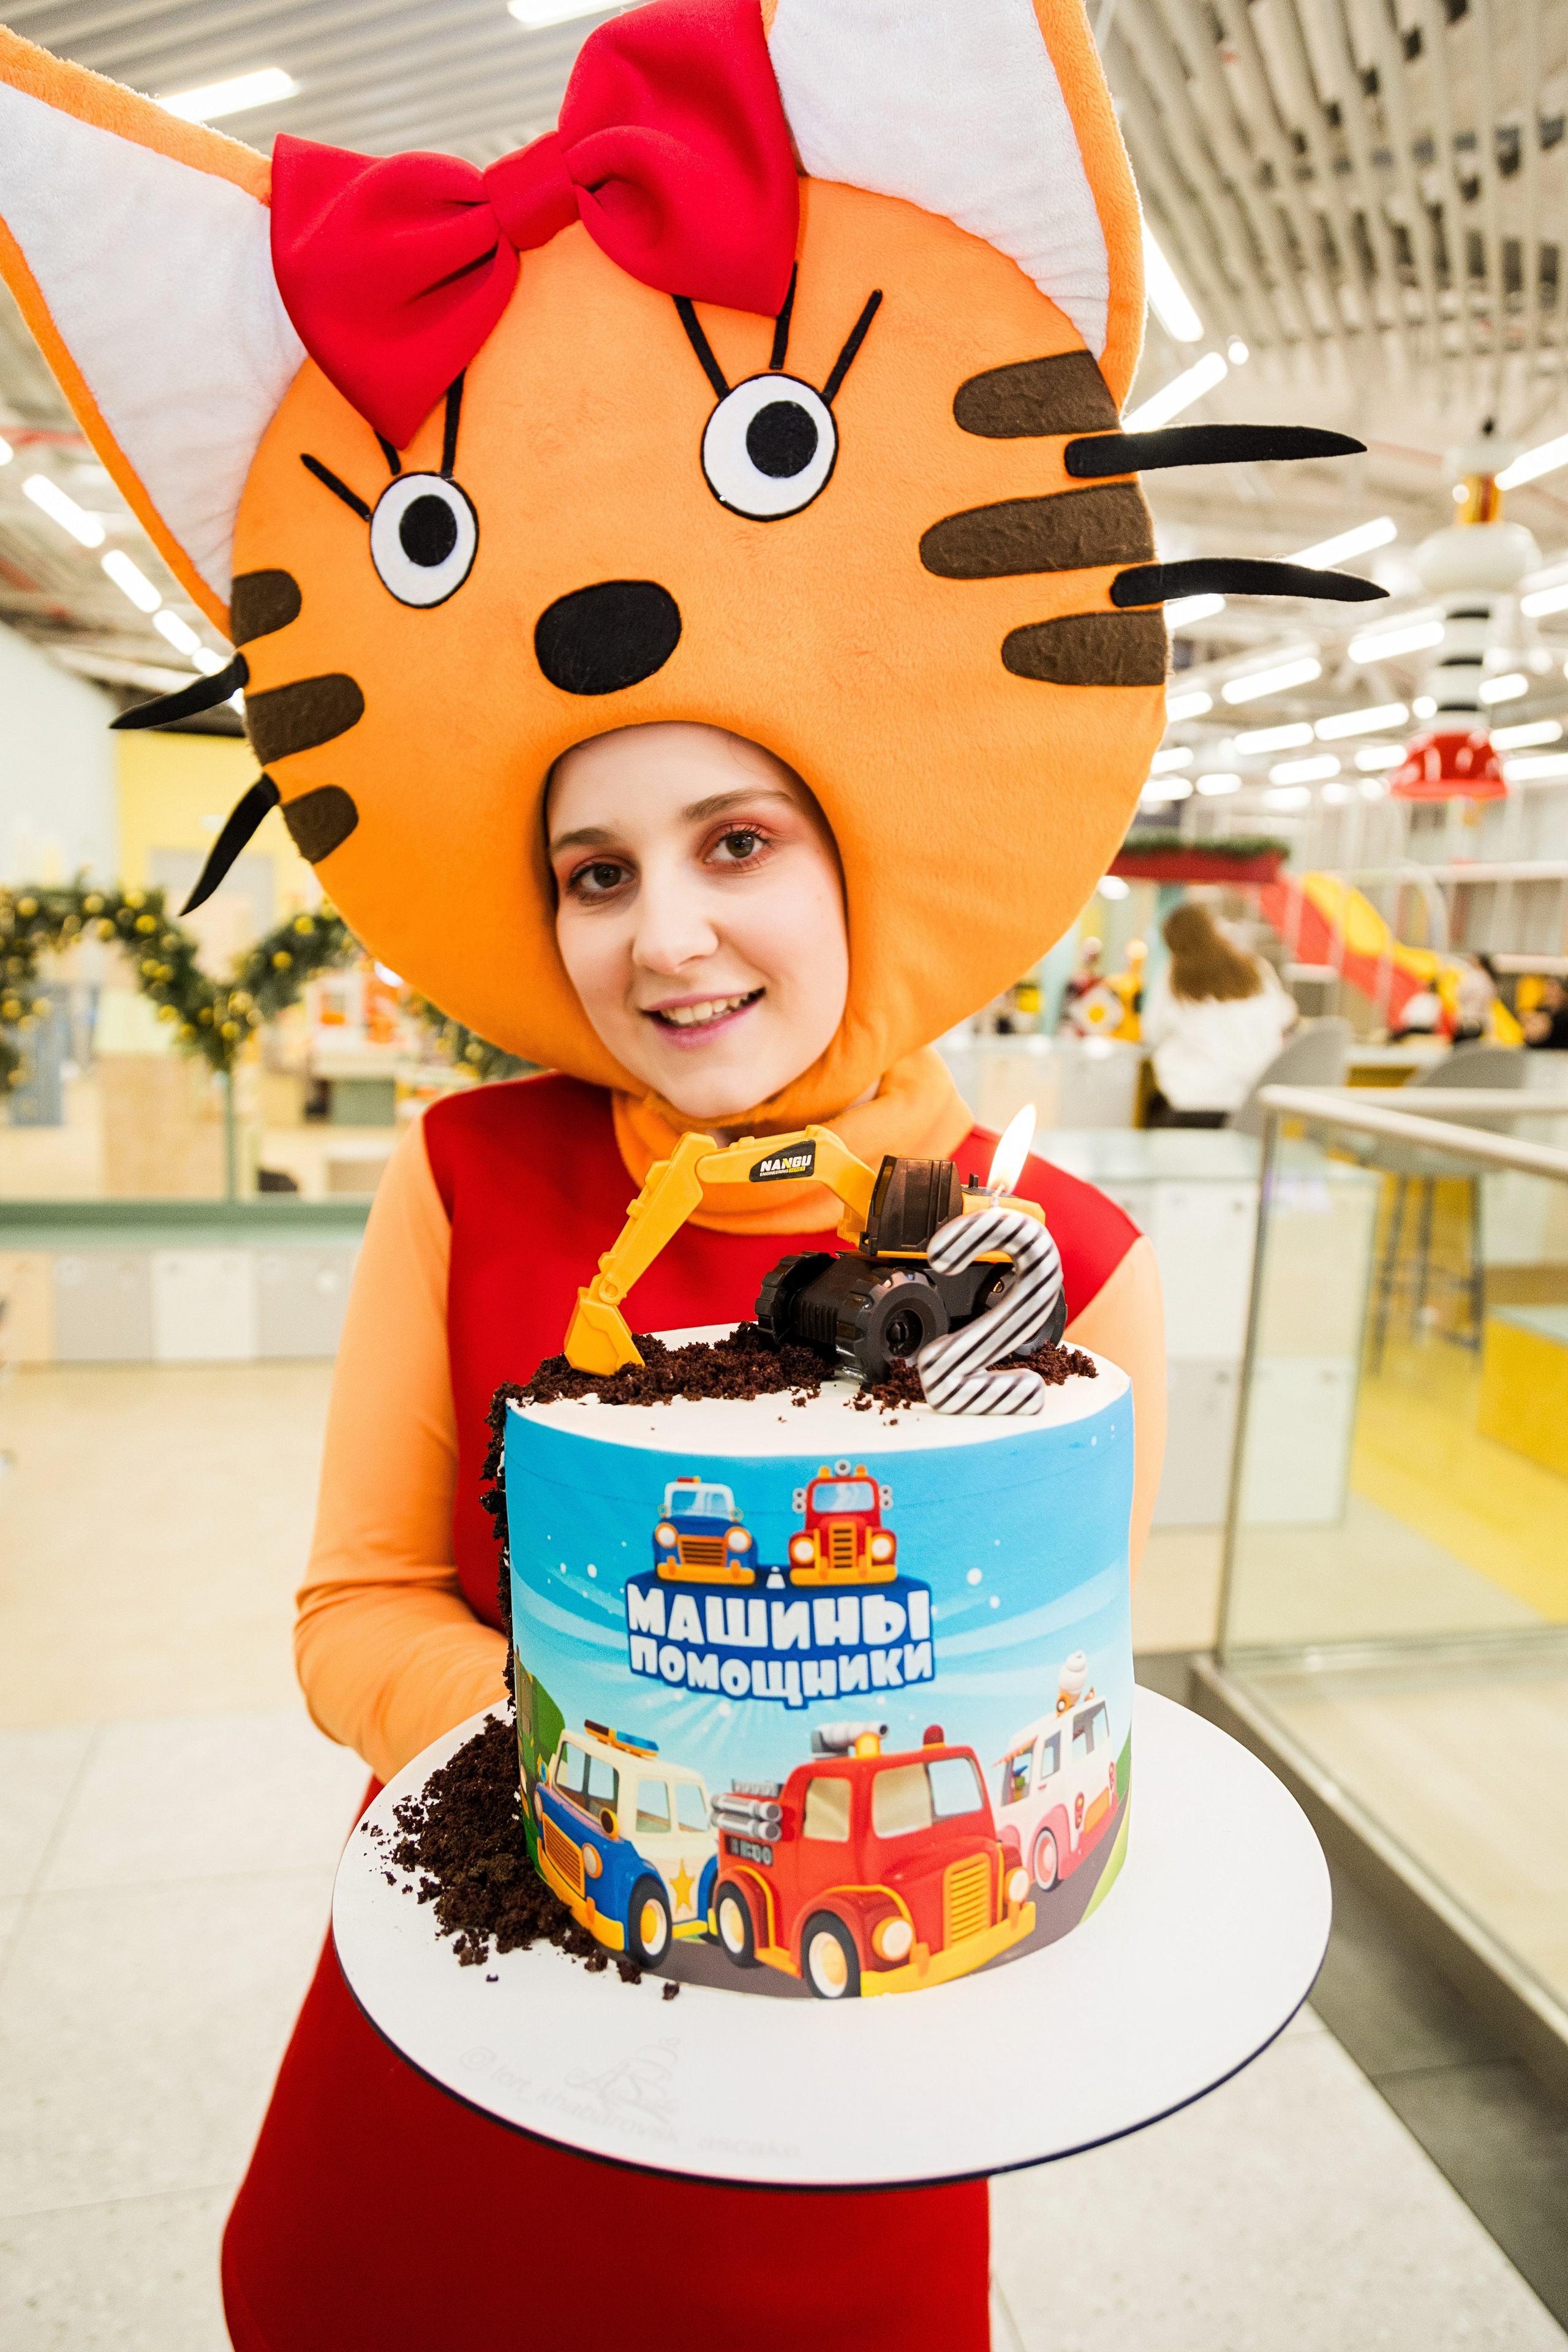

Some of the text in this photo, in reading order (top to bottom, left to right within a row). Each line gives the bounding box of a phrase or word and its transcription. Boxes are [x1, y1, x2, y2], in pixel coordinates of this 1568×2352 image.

[760, 1155, 812, 1172] NANGU
[918, 1207, 1064, 1415] 2
[627, 1583, 930, 1651] МАШИНЫ
[630, 1635, 932, 1706] ПОМОЩНИКИ
